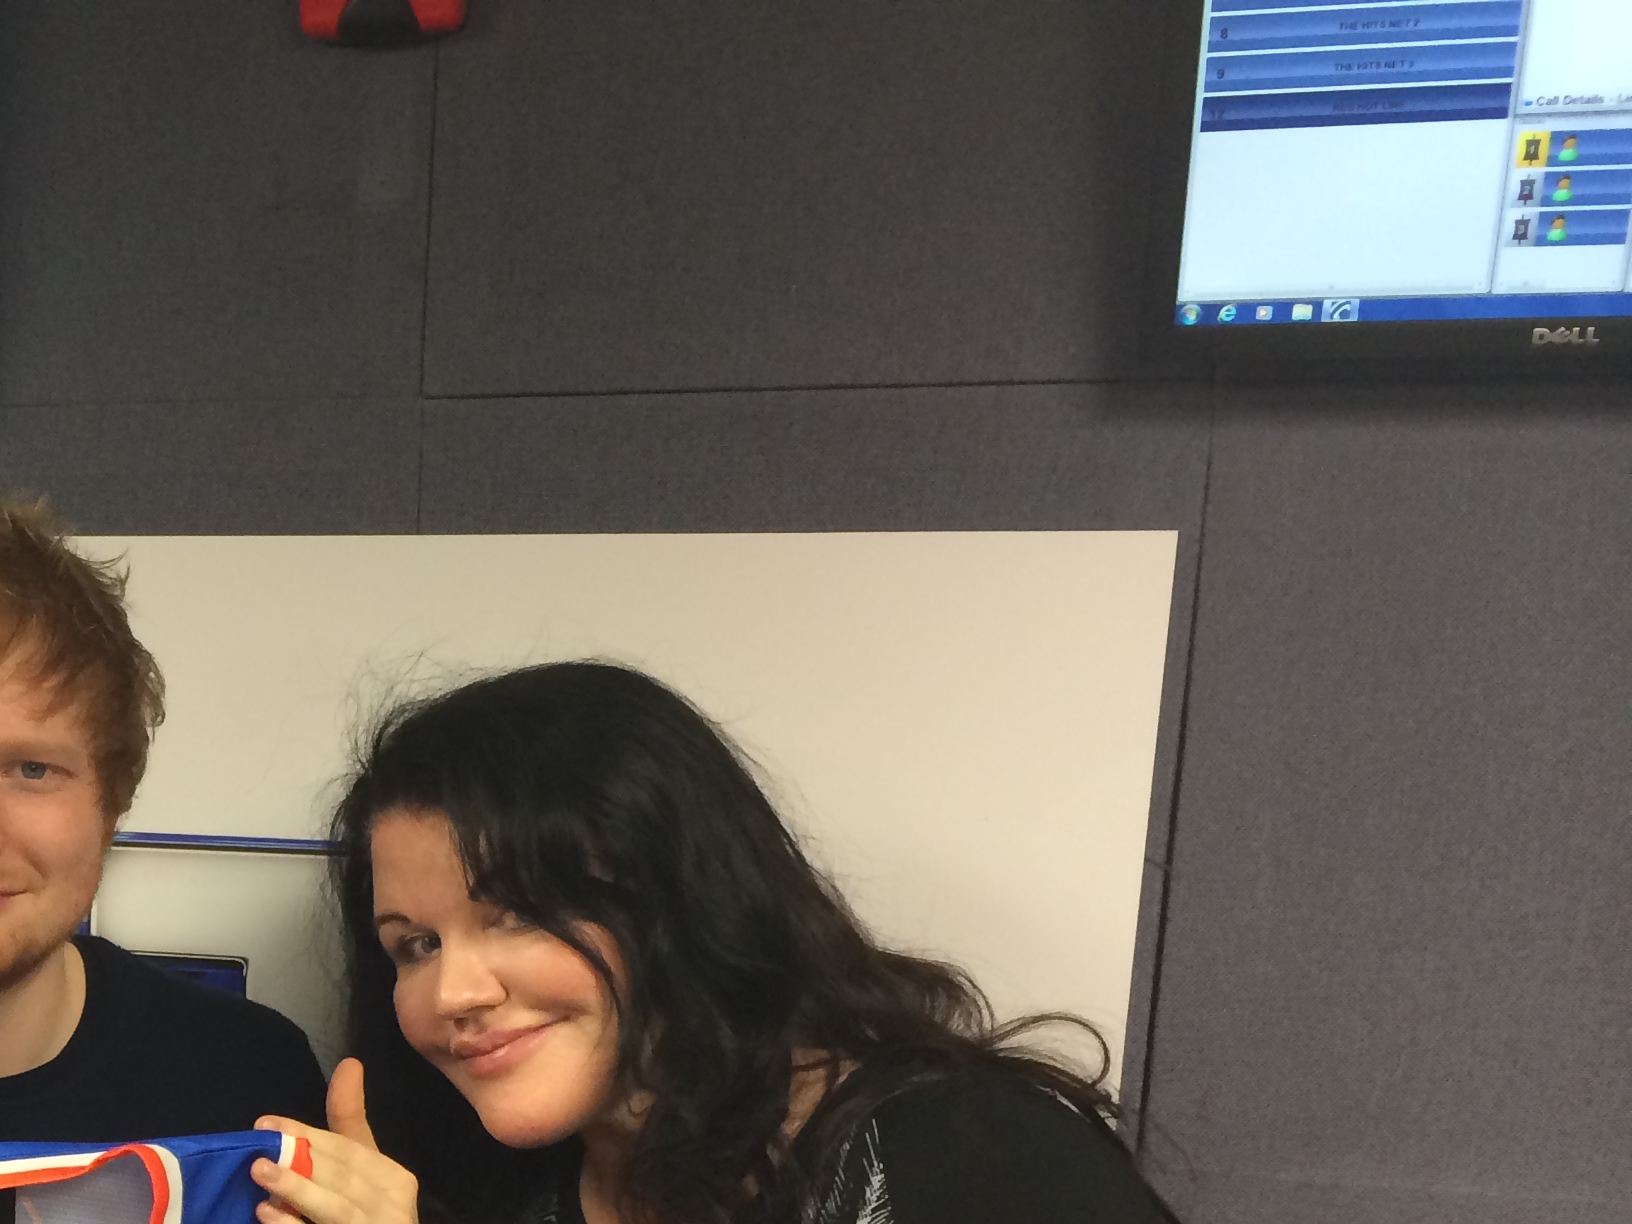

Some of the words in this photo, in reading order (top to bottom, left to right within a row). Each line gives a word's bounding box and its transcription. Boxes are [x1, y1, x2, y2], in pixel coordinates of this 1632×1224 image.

[1536, 95, 1559, 107] Call
[1562, 94, 1605, 106] Details
[1531, 326, 1601, 347] DELL
